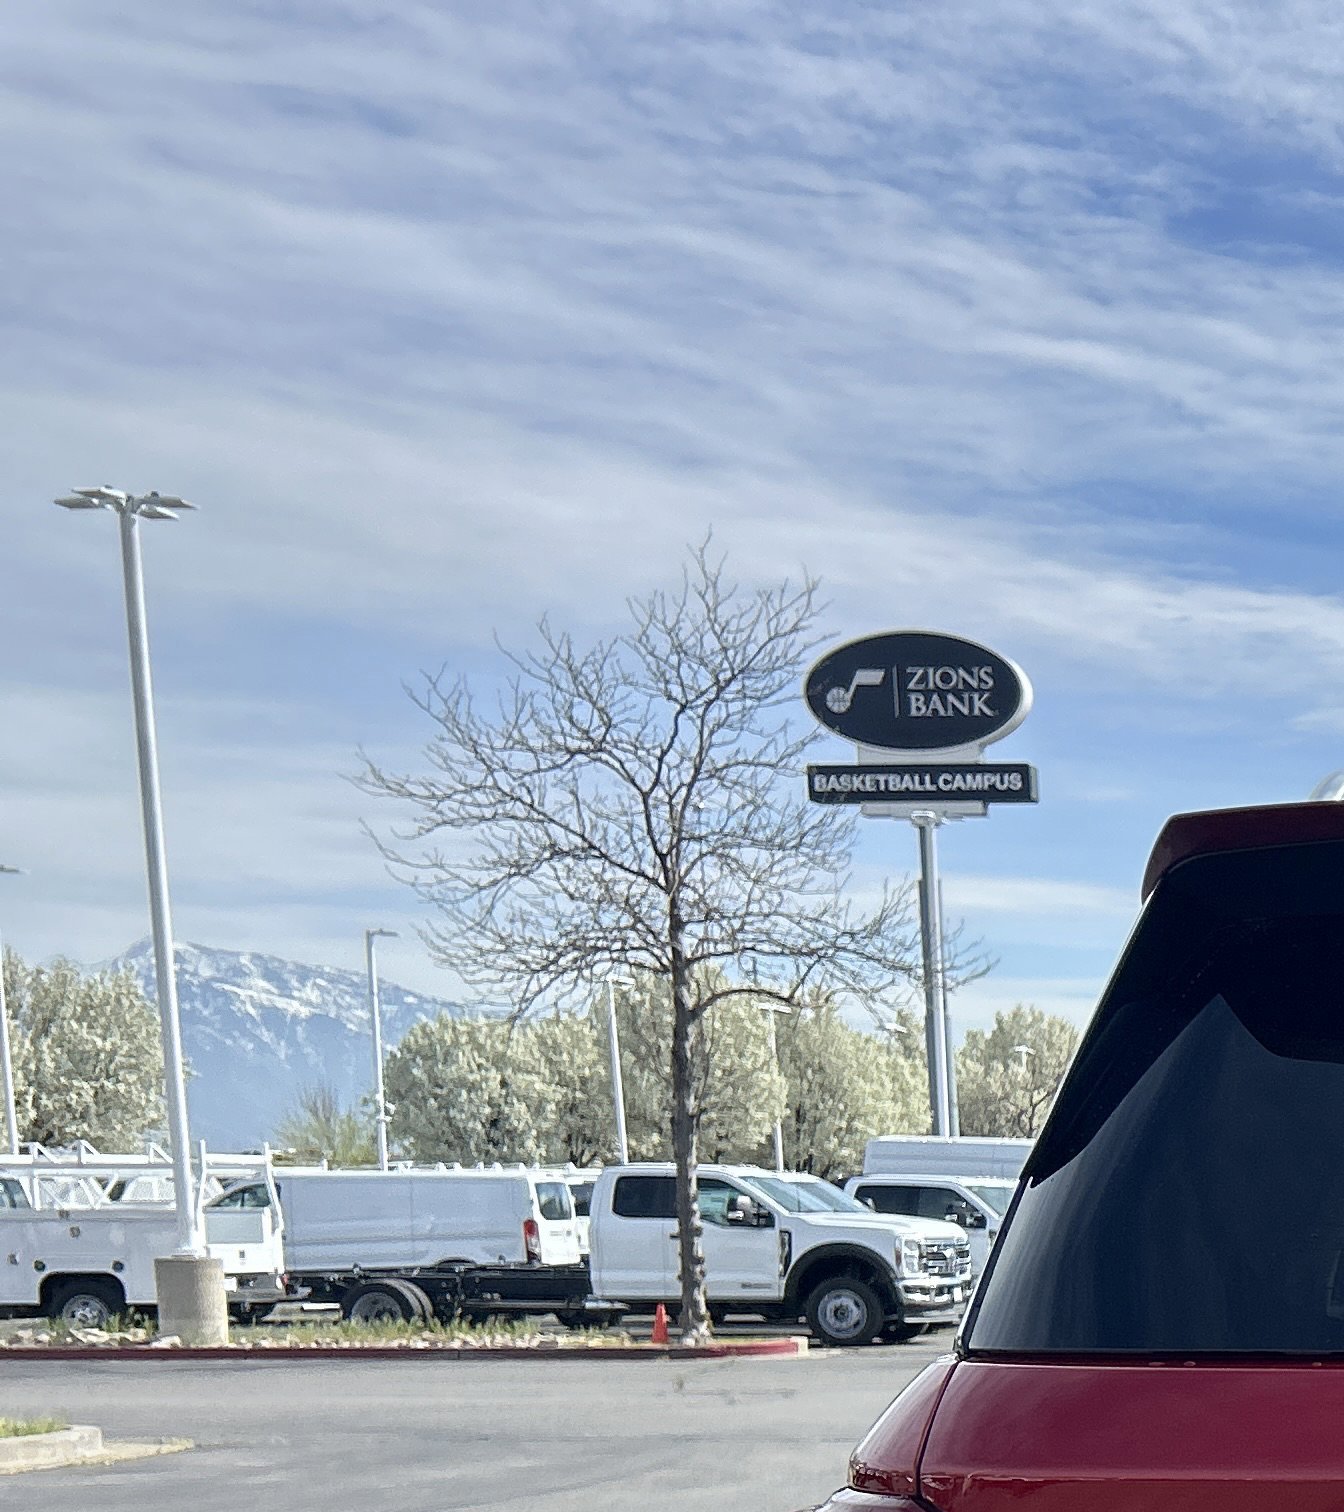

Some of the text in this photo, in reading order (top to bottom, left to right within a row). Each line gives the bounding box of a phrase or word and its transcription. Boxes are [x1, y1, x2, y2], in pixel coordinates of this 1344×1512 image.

[906, 666, 994, 690] ZIONS
[909, 692, 997, 717] BANK
[814, 773, 1022, 792] BASKETBALL CAMPUS
